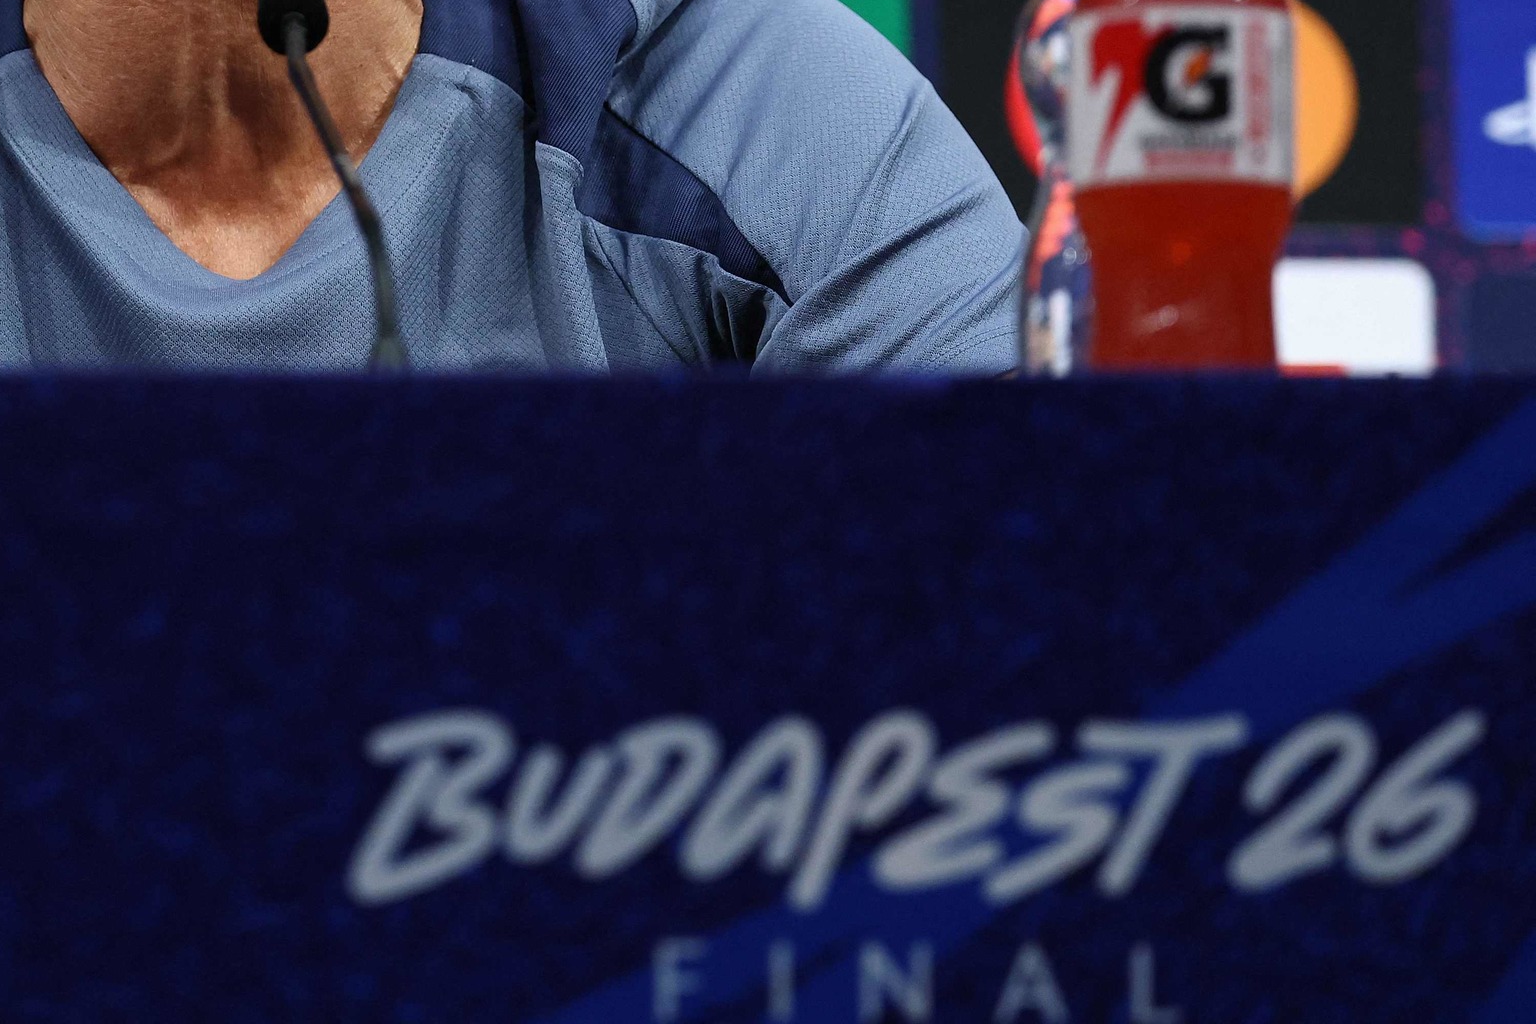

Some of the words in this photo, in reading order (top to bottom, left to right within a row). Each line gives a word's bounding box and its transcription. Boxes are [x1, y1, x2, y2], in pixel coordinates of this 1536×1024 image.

[1144, 23, 1232, 125] G
[348, 706, 1254, 912] BUDAPEST
[1226, 709, 1485, 894] 26
[650, 935, 1186, 1023] FINAL
